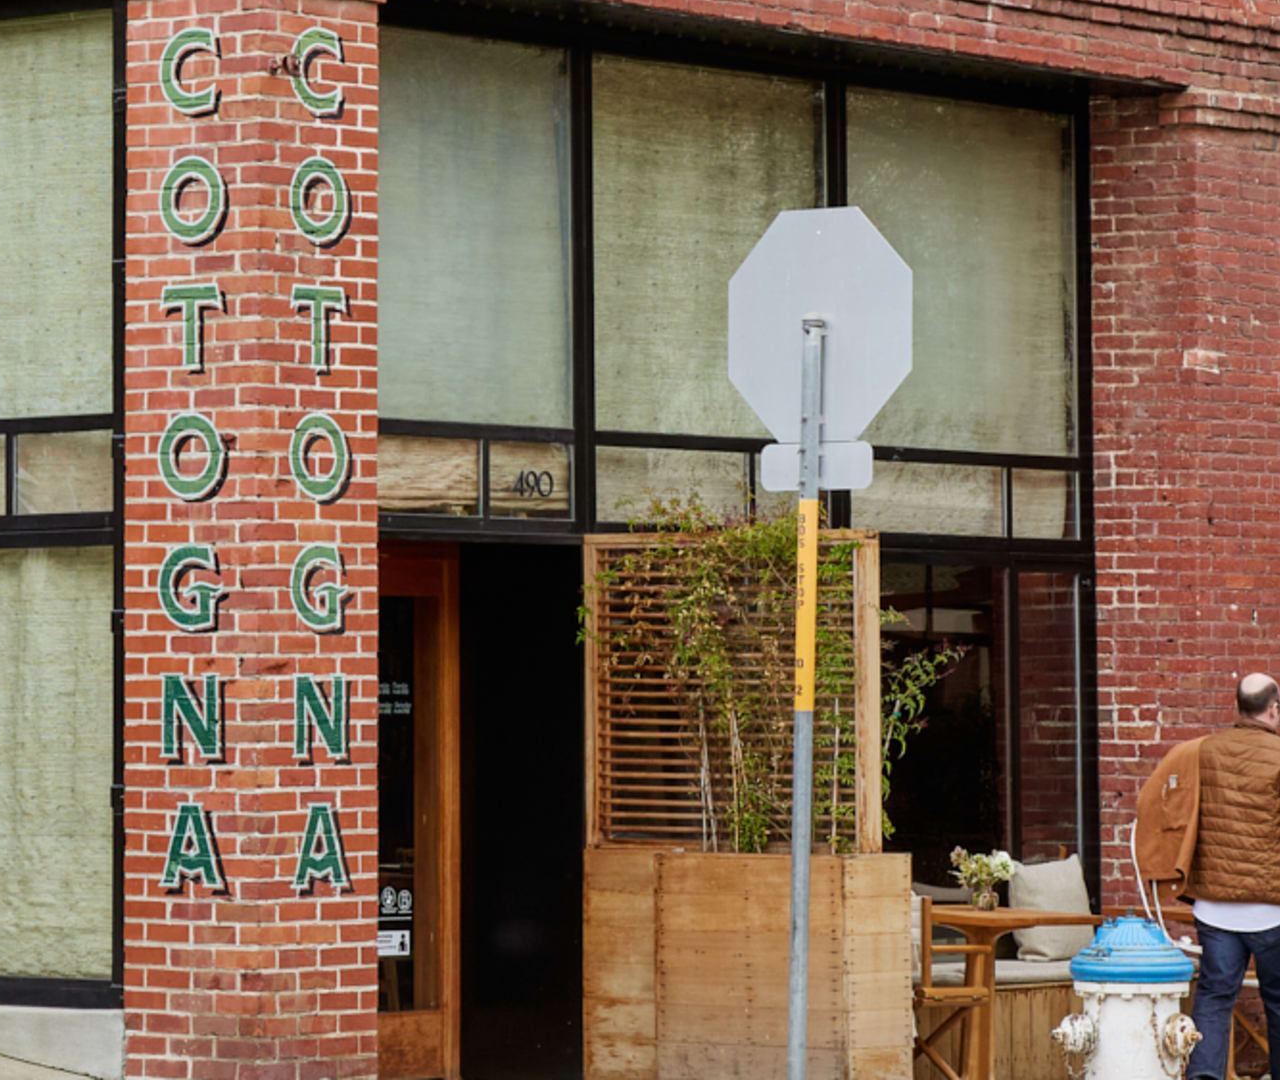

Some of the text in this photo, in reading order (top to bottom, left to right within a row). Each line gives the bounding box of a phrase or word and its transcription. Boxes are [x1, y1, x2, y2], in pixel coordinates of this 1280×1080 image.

[157, 27, 231, 893] COTOGNA
[290, 27, 355, 893] COTOGNA
[512, 469, 554, 497] 490
